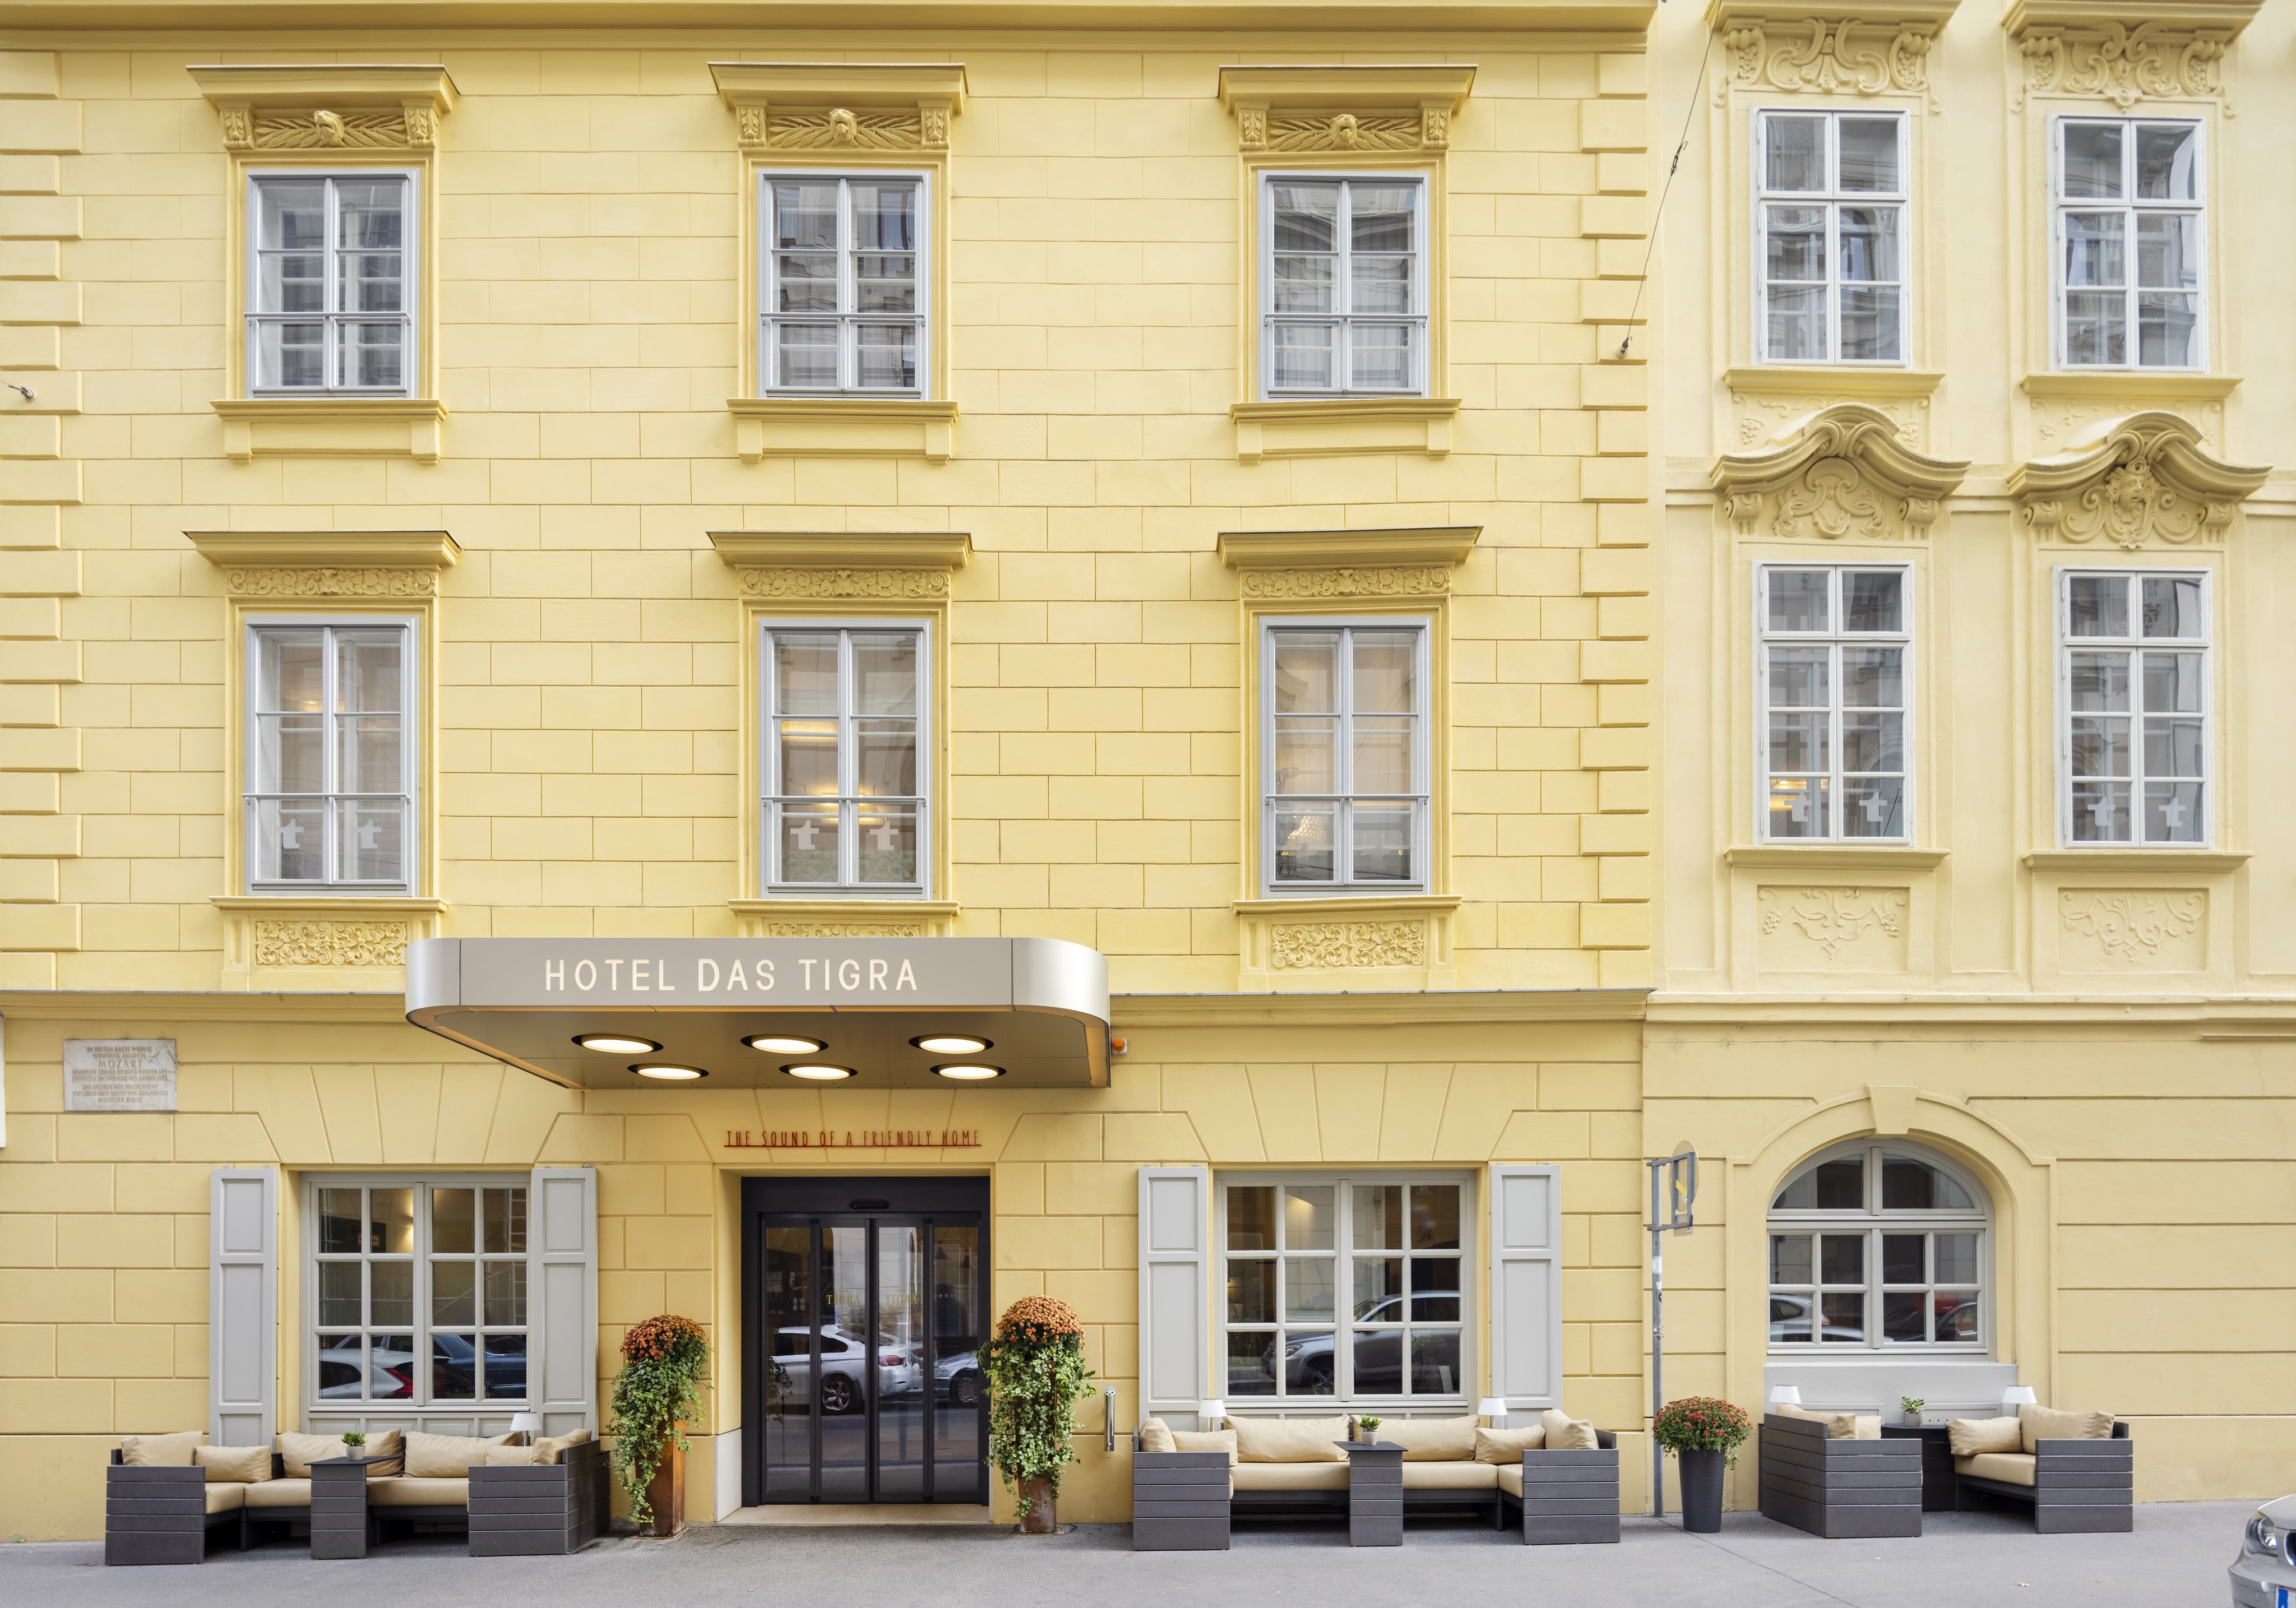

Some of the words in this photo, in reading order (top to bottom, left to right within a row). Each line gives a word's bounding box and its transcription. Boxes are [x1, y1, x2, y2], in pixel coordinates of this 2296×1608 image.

[1859, 792, 1887, 822] t
[2087, 796, 2116, 826] t
[2159, 797, 2186, 827] t
[275, 819, 304, 849] t
[353, 819, 382, 849] t
[790, 820, 820, 850] t
[869, 821, 899, 851] t
[545, 958, 675, 991] HOTEL
[698, 958, 775, 991] DAS
[798, 958, 918, 991] TIGRA
[98, 1059, 143, 1068] MOZART
[727, 1130, 751, 1146] THE
[762, 1130, 808, 1146] SOUND
[820, 1130, 835, 1146] OF
[846, 1130, 853, 1146] A
[863, 1130, 931, 1146] FRIENDLY
[943, 1130, 979, 1146] HOME
[826, 1294, 860, 1305] TIGRA
[885, 1294, 918, 1304] TIGRA
